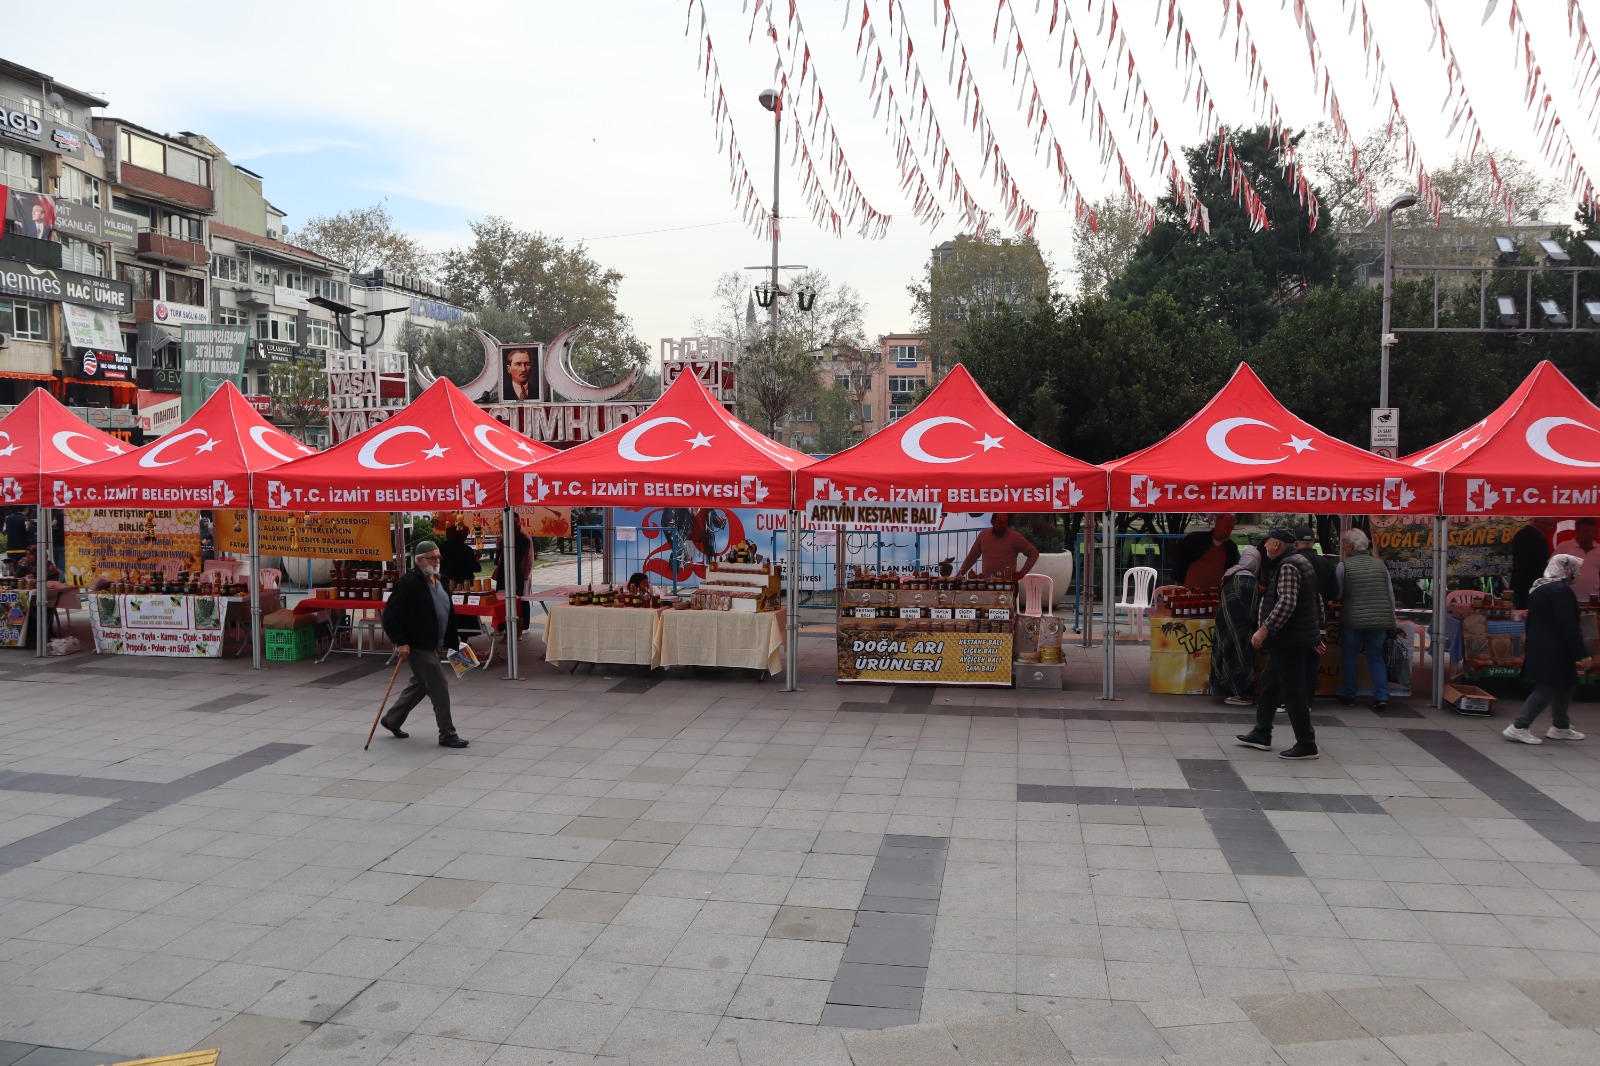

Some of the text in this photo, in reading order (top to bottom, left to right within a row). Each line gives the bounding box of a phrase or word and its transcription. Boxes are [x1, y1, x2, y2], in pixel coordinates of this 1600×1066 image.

[56, 204, 71, 216] MİT
[55, 216, 96, 234] ŞKANLIĞI
[104, 217, 133, 233] İYİLERİN
[66, 282, 125, 306] HAC UMRE
[170, 308, 182, 318] TÜRK
[665, 361, 716, 387] GZİ
[153, 405, 180, 425] MAHMUT
[74, 484, 212, 501] T.C. İZMİT BELEDİYESİ
[294, 485, 460, 503] T.C. İZMİT BELEDİYESİ
[552, 479, 739, 498] T.C. İZMİT BELEDİYESİ
[844, 484, 1052, 503] T.C. İZMİT BELEDİYESİ
[1164, 481, 1381, 502] T.C. İZMİT BELEDİYESİ
[1502, 487, 1546, 504] T.C.
[94, 509, 107, 518] ARI
[811, 502, 855, 523] ARTVİN
[857, 504, 909, 524] KESTANE
[910, 507, 937, 525] BALI
[119, 522, 147, 532] BİRLİĞ
[229, 541, 249, 549] FATMA
[258, 543, 278, 551] APLAN
[141, 631, 156, 642] Yayla
[160, 632, 178, 641] Karma
[958, 638, 987, 646] KESTANE
[1177, 626, 1216, 654] TA
[126, 643, 147, 653] Propolis
[151, 643, 166, 652] Polen
[852, 638, 945, 655] DOĞAL ARI
[963, 647, 982, 655] ÇİÇEK
[855, 655, 942, 672] ÜRÜNLERİ
[965, 665, 980, 673] ÇAM
